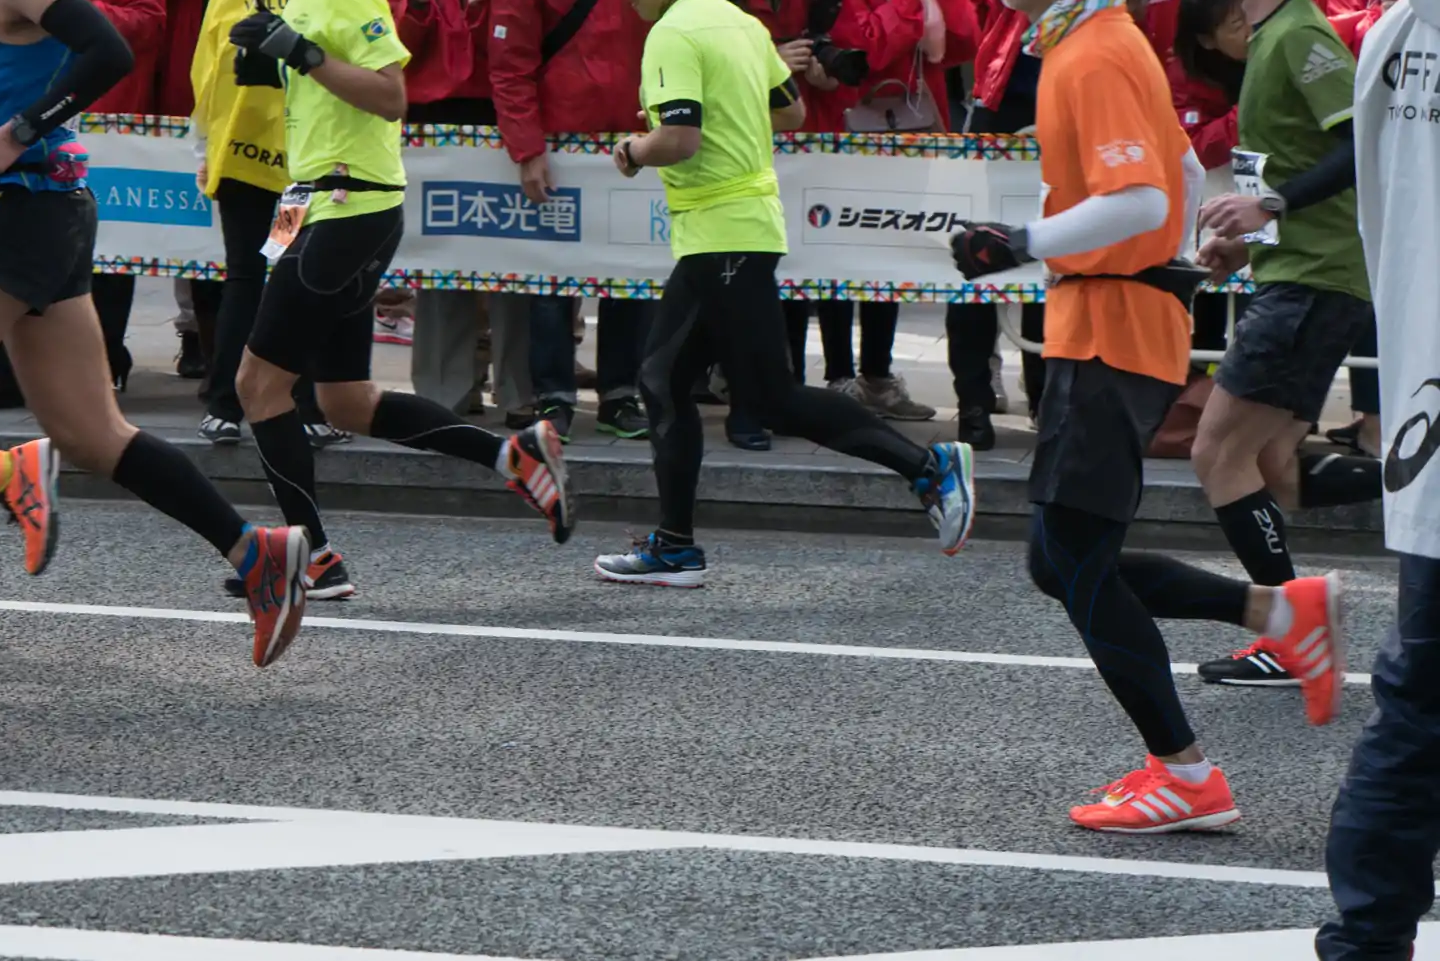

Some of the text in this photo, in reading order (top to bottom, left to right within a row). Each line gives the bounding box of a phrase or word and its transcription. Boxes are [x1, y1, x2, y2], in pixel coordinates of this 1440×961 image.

[105, 185, 209, 212] ANESSA
[426, 190, 577, 234] 日本光電
[837, 207, 971, 233] シミズオクト
